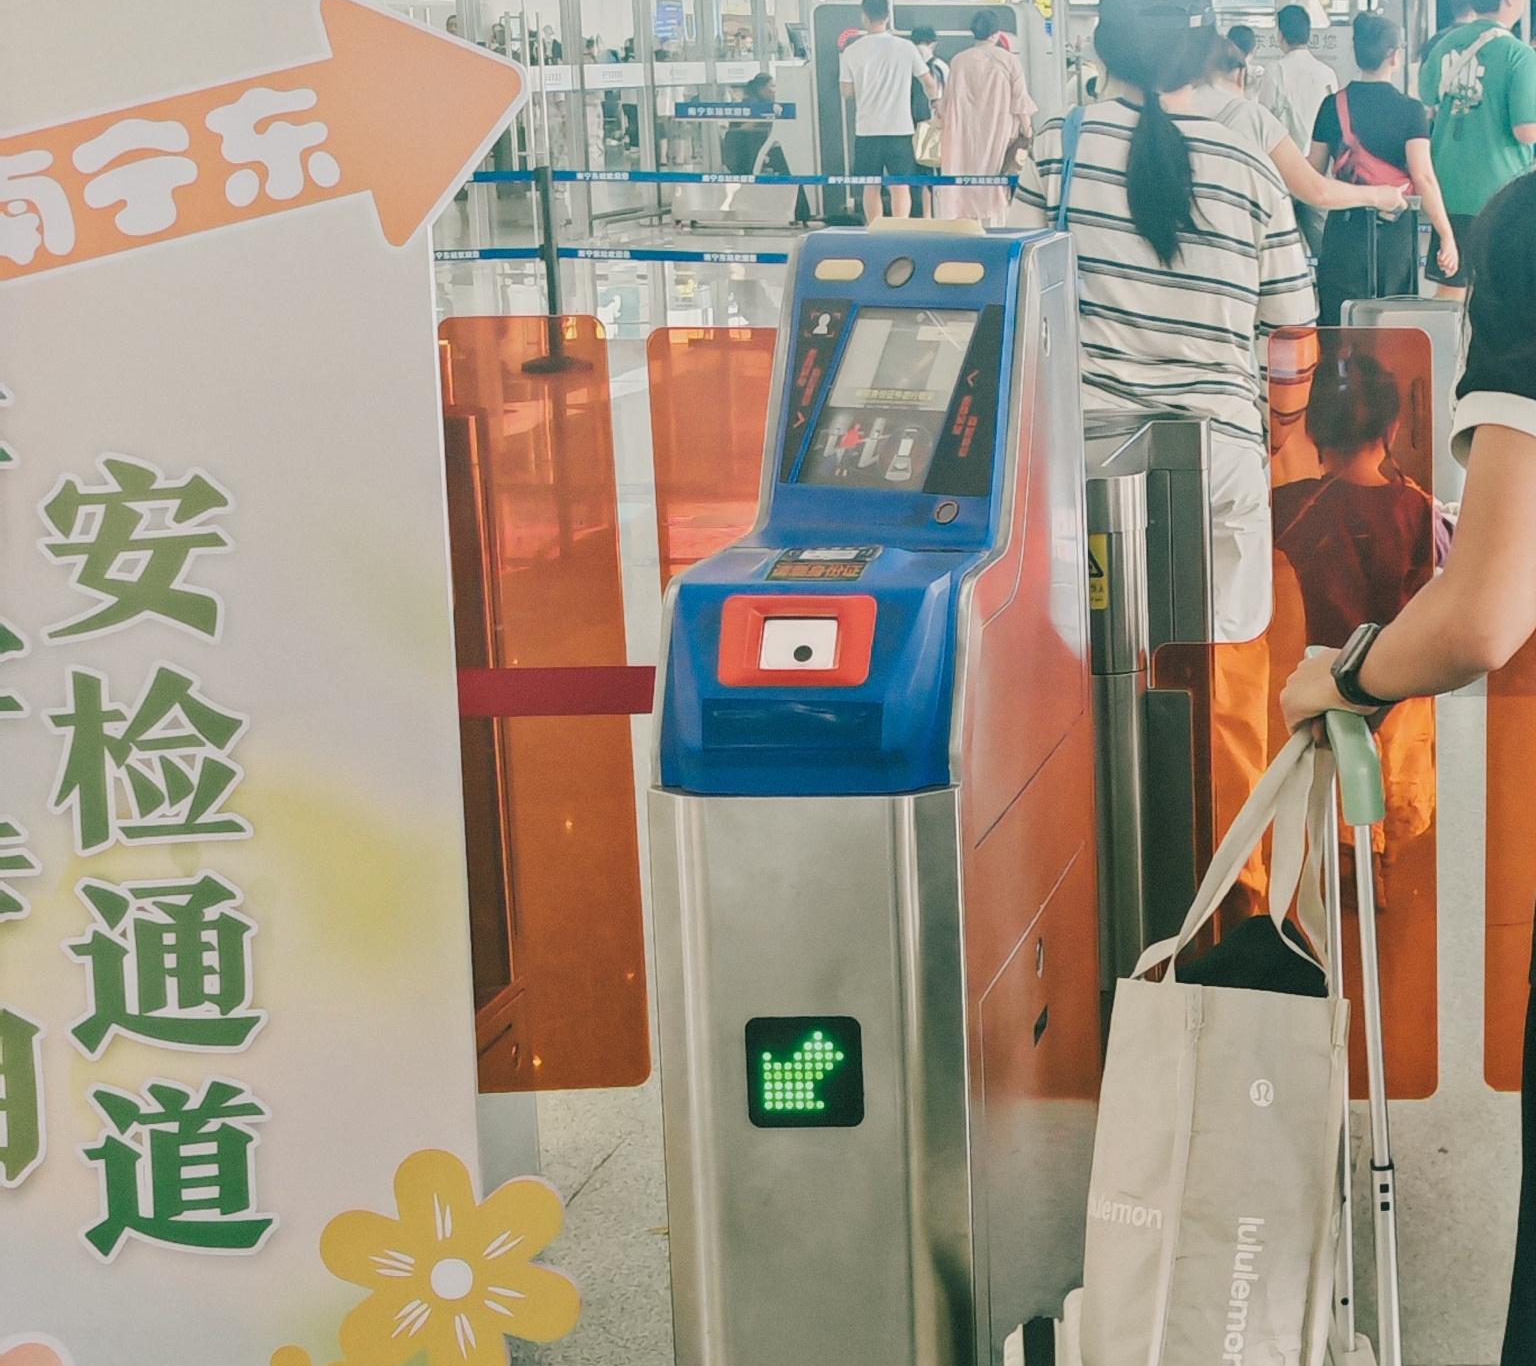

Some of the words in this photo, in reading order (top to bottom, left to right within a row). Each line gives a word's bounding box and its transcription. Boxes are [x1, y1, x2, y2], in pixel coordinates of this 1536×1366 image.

[434, 251, 480, 260] 宁东站欢迎您
[42, 455, 276, 1260] 安检通道
